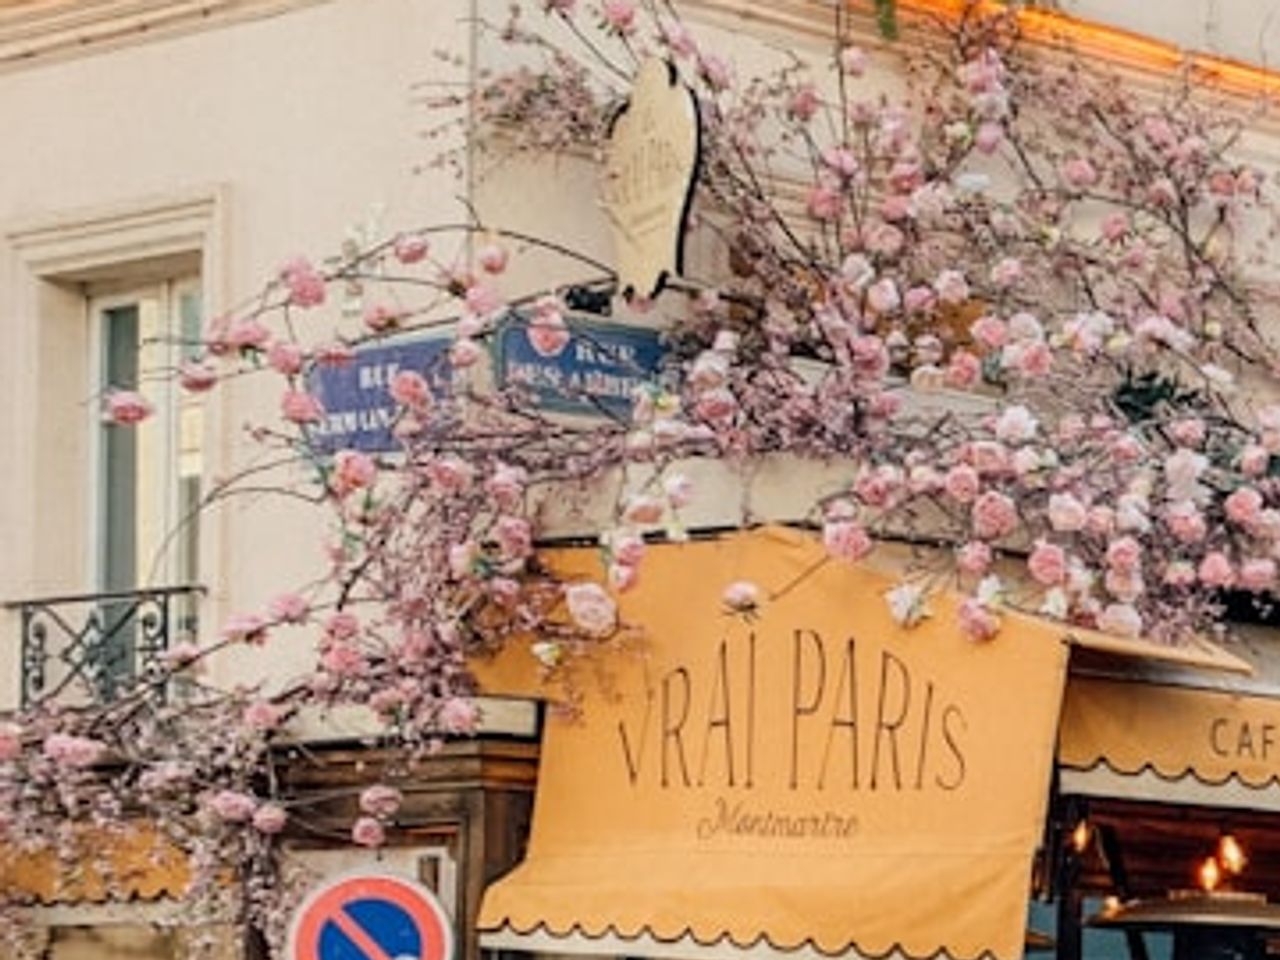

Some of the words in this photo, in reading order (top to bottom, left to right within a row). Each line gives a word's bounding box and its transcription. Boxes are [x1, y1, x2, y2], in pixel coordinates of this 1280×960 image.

[618, 630, 757, 790] VRAI
[789, 628, 969, 792] PARIS
[696, 796, 860, 840] Montmartre
